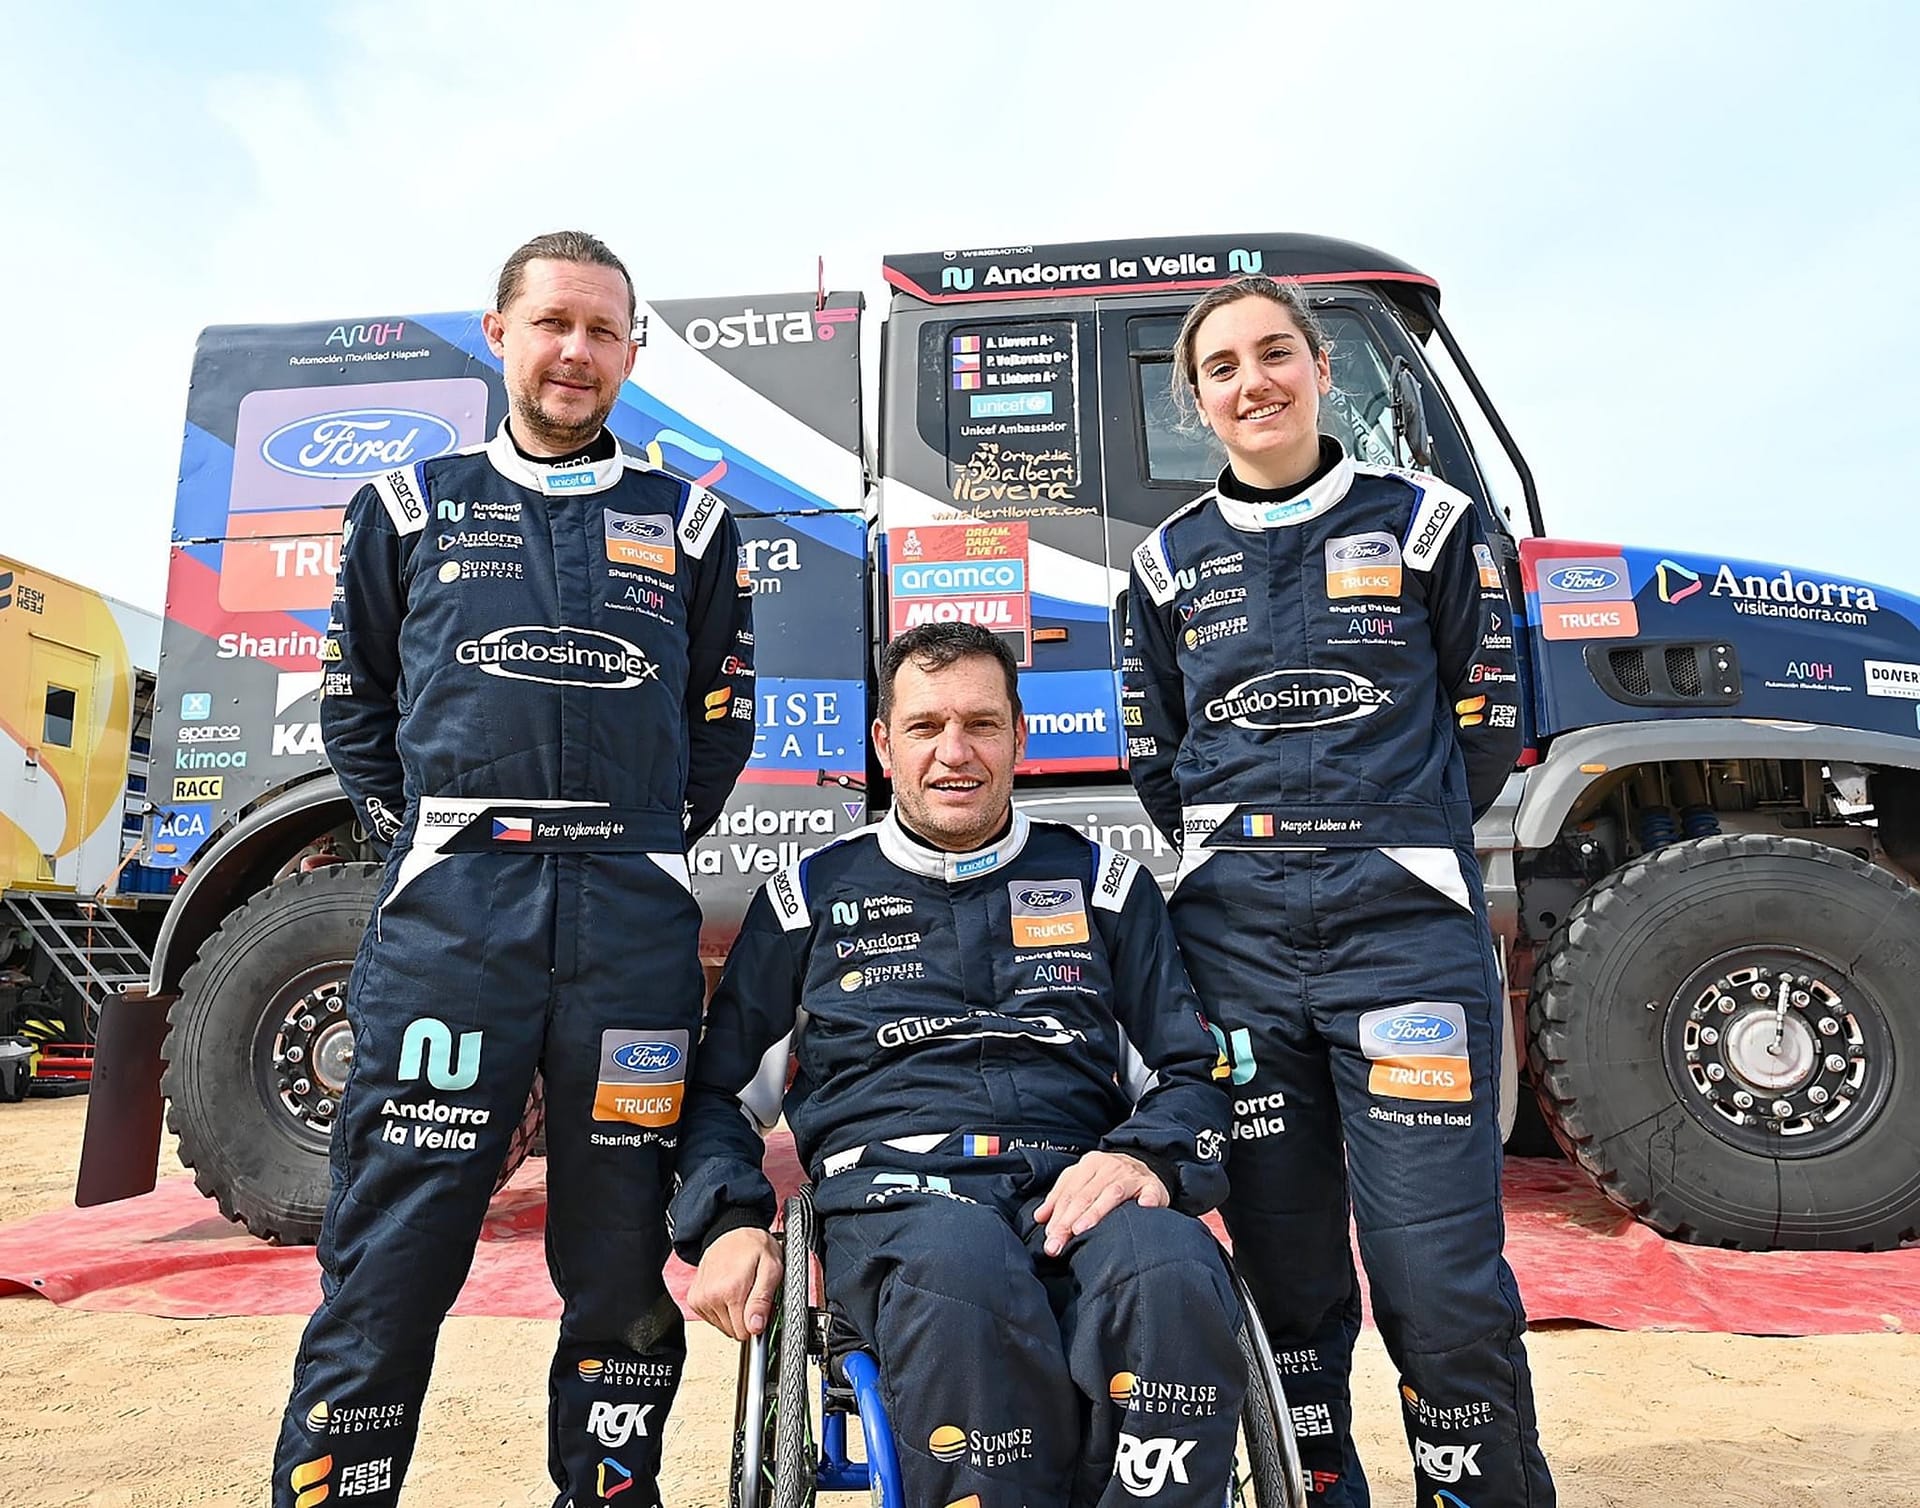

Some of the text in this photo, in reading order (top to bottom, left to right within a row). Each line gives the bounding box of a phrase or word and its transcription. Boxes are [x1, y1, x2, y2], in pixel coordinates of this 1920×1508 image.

[984, 255, 1215, 286] Andorra la Vella
[685, 308, 813, 350] ostra
[977, 400, 1026, 414] unicef
[961, 421, 1067, 436] Unicef Ambassador
[299, 419, 419, 467] Ford
[471, 501, 522, 512] Andorra
[474, 511, 486, 520] la
[684, 493, 717, 543] sparco
[455, 531, 523, 545] Andorra
[1413, 500, 1455, 559] sparco
[619, 545, 664, 564] TRUCKS
[461, 560, 523, 573] SUNRISE
[902, 566, 1015, 588] aramco
[1339, 576, 1390, 589] TRUCKS
[1561, 570, 1605, 590] Ford
[17, 585, 45, 603] FESH
[1709, 564, 1879, 612] Andorra
[905, 600, 1012, 626] MOTUL
[1559, 612, 1620, 628] TRUCKS
[1733, 599, 1867, 626] visitandorra.com
[1197, 616, 1248, 638] SUNRISE
[455, 638, 660, 681] Guidosimplex
[1204, 683, 1395, 722] Guidosimplex
[175, 748, 247, 769] kimoa
[176, 779, 220, 797] RACC
[537, 823, 560, 837] Petr
[1280, 820, 1312, 835] Margot
[1028, 890, 1064, 906] Ford
[867, 909, 880, 921] la
[1026, 922, 1074, 938] TRUCKS
[854, 932, 921, 952] Andorra
[864, 963, 924, 979] SUNRISE
[1388, 1018, 1440, 1039] Ford
[627, 1045, 671, 1068] Ford
[1388, 1068, 1455, 1087] TRUCKS
[380, 1099, 490, 1125] Andorra
[614, 1096, 672, 1114] TRUCKS
[1368, 1107, 1472, 1126] Sharing the load
[382, 1119, 477, 1150] la Vella
[590, 1132, 642, 1147] Sharing
[604, 1358, 673, 1376] SUNRISE
[1129, 1375, 1217, 1402] SUNRISE
[330, 1403, 404, 1425] SUNRISE
[1419, 1397, 1491, 1420] SUNRISE
[341, 1456, 392, 1482] FESH
